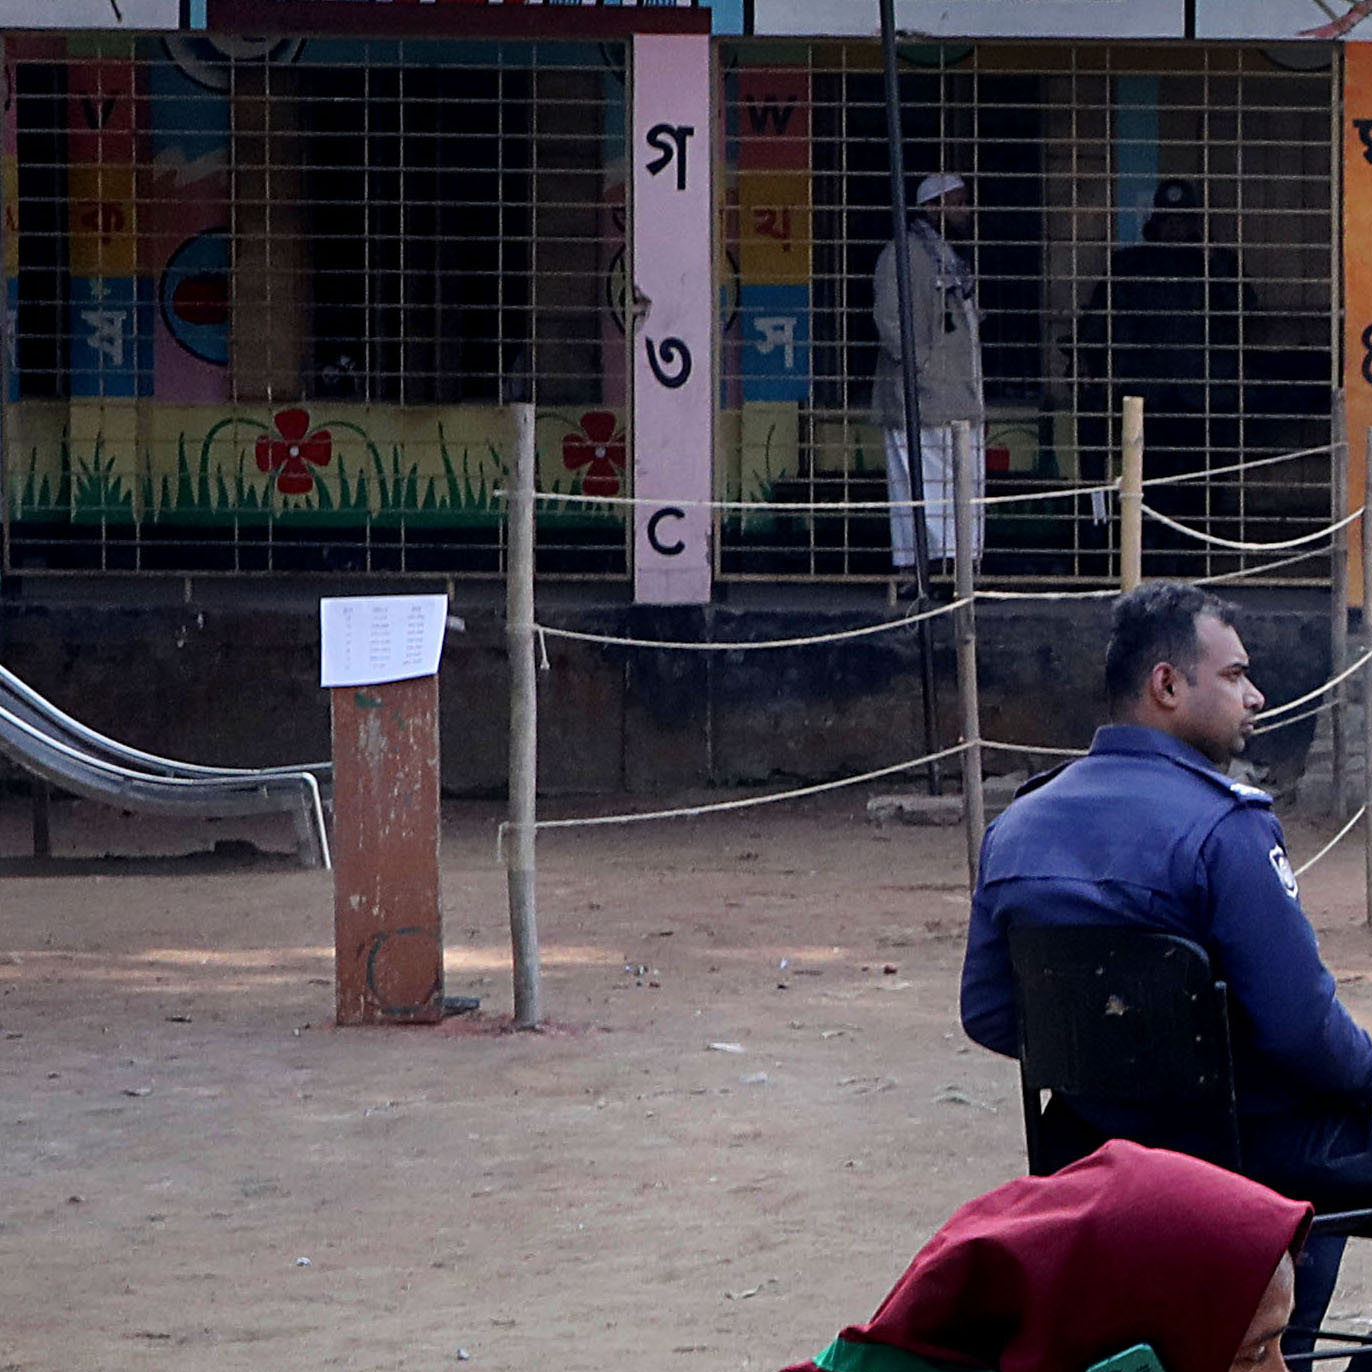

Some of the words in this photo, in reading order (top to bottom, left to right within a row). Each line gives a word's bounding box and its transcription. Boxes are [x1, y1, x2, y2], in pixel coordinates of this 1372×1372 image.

[744, 95, 797, 135] W
[646, 123, 695, 190] গ
[645, 336, 692, 388] ৩
[647, 507, 686, 555] C
